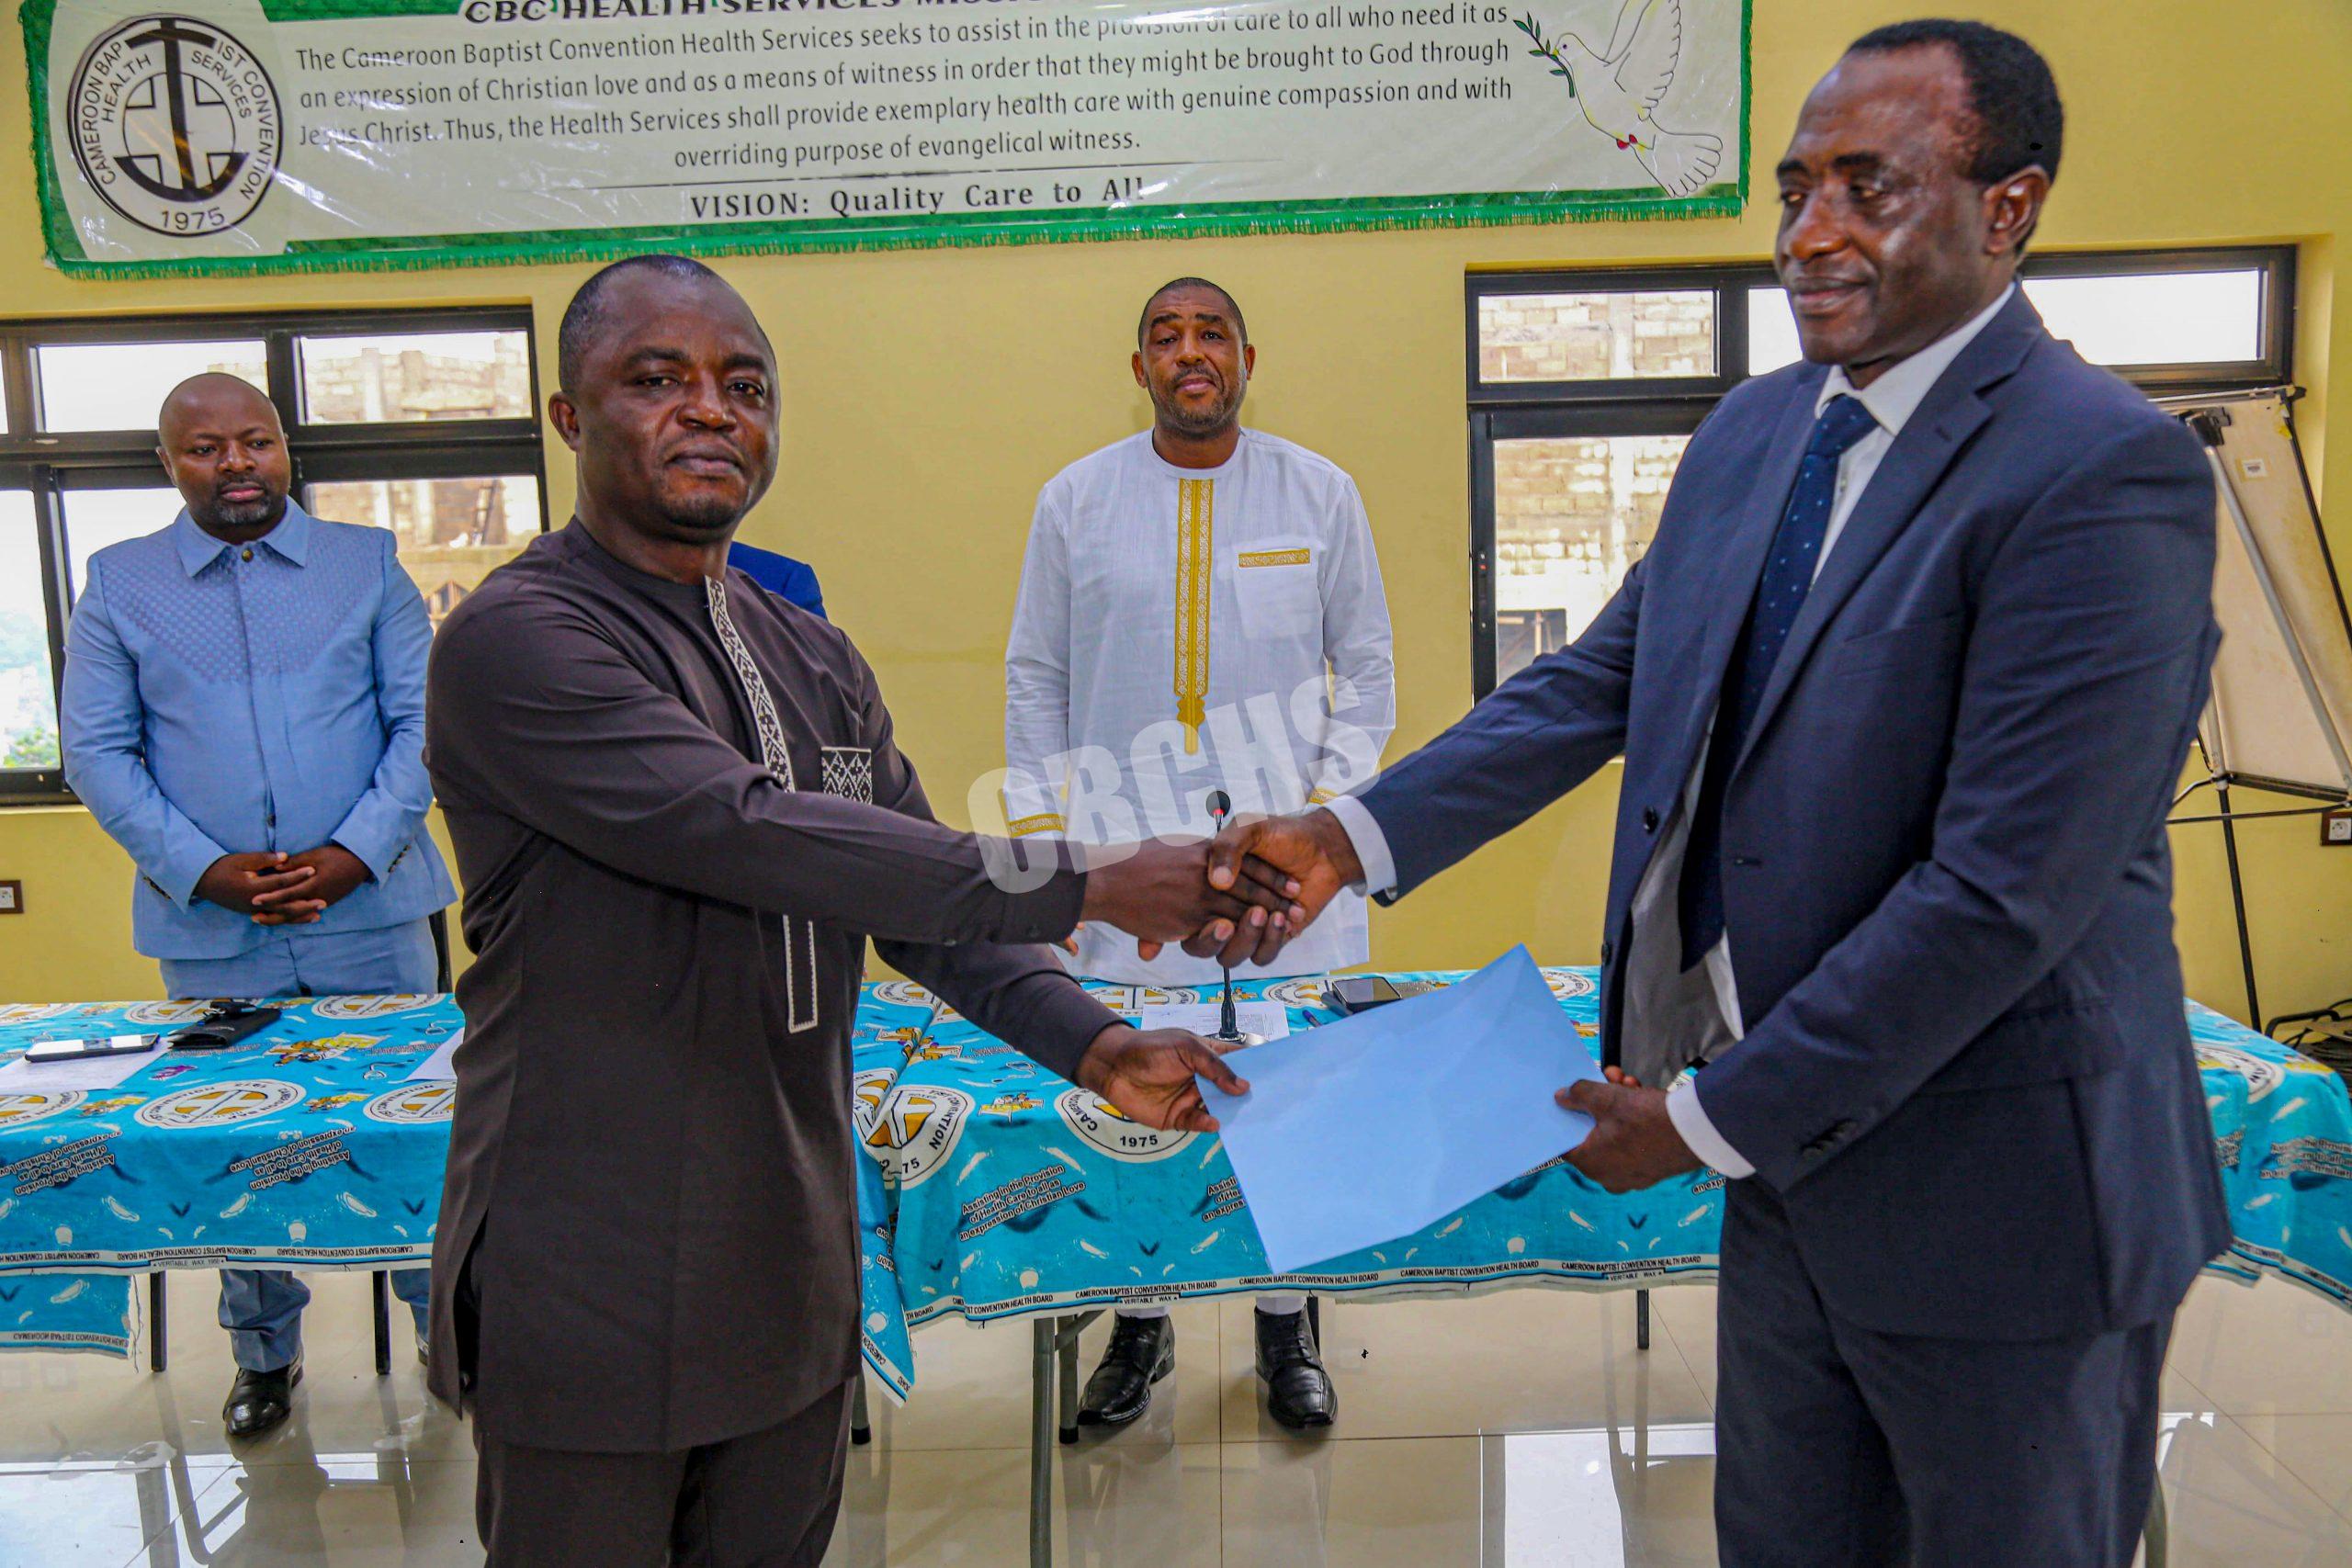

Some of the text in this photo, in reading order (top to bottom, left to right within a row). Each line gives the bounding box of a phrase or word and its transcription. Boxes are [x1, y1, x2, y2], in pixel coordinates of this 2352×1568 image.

[465, 0, 546, 24] CBC
[562, 0, 706, 19] HEALTH
[296, 49, 335, 71] The
[343, 47, 457, 69] Cameroon
[464, 40, 544, 67] Baptist
[550, 34, 675, 60] Convention
[682, 29, 755, 54] Health
[763, 26, 854, 51] Services
[861, 22, 922, 46] seeks
[929, 23, 951, 43] to
[957, 17, 1022, 41] assist
[1028, 16, 1048, 39] in
[1056, 15, 1091, 39] the
[1234, 12, 1282, 32] care
[1288, 9, 1309, 29] to
[1316, 6, 1341, 29] all
[1349, 4, 1395, 28] who
[1402, 3, 1455, 26] need
[1463, 2, 1477, 24] it
[1484, 6, 1508, 23] as
[101, 51, 252, 123] HEALTH SERVICES
[300, 39, 1510, 112] an expression of Christian love and as a means of witness in order that they might be brought to God through
[444, 117, 503, 141] Thus,
[509, 117, 544, 138] the
[551, 112, 624, 136] Health
[630, 107, 721, 132] Services
[728, 104, 779, 129] shall
[786, 100, 869, 130] provide
[876, 96, 991, 125] exemplary
[997, 92, 1068, 118] health
[1074, 95, 1120, 113] care
[1126, 88, 1175, 111] with
[1182, 85, 1272, 114] genuine
[1278, 80, 1410, 108] compassion
[1417, 78, 1458, 101] and
[1464, 76, 1512, 100] with
[82, 75, 117, 185] CAMEROON
[240, 71, 274, 200] CONVENTION
[674, 129, 1140, 169] overriding purpose of evangelical witness.
[691, 176, 1144, 219] VISION: Quality Care to All
[161, 207, 225, 230] 1975
[1120, 1134, 1159, 1147] 1975
[1400, 1260, 1539, 1278] CAMEROON BAPTIST CONVENTION HEALTH BOARD
[1562, 1256, 1702, 1271] CAMEROON BAPTIST CONVENTION HEALTH BOARD
[1075, 1281, 1217, 1298] CAMEROON BAPTIST CONVENTION HEALTH BOARD
[1239, 1273, 1379, 1285] CAMEROON BAPTIST CONVENTION HEALTH BOARD
[974, 1302, 1010, 1314] CONVENTION
[1011, 1297, 1032, 1308] HEALTH
[1032, 1294, 1054, 1303] BOARD
